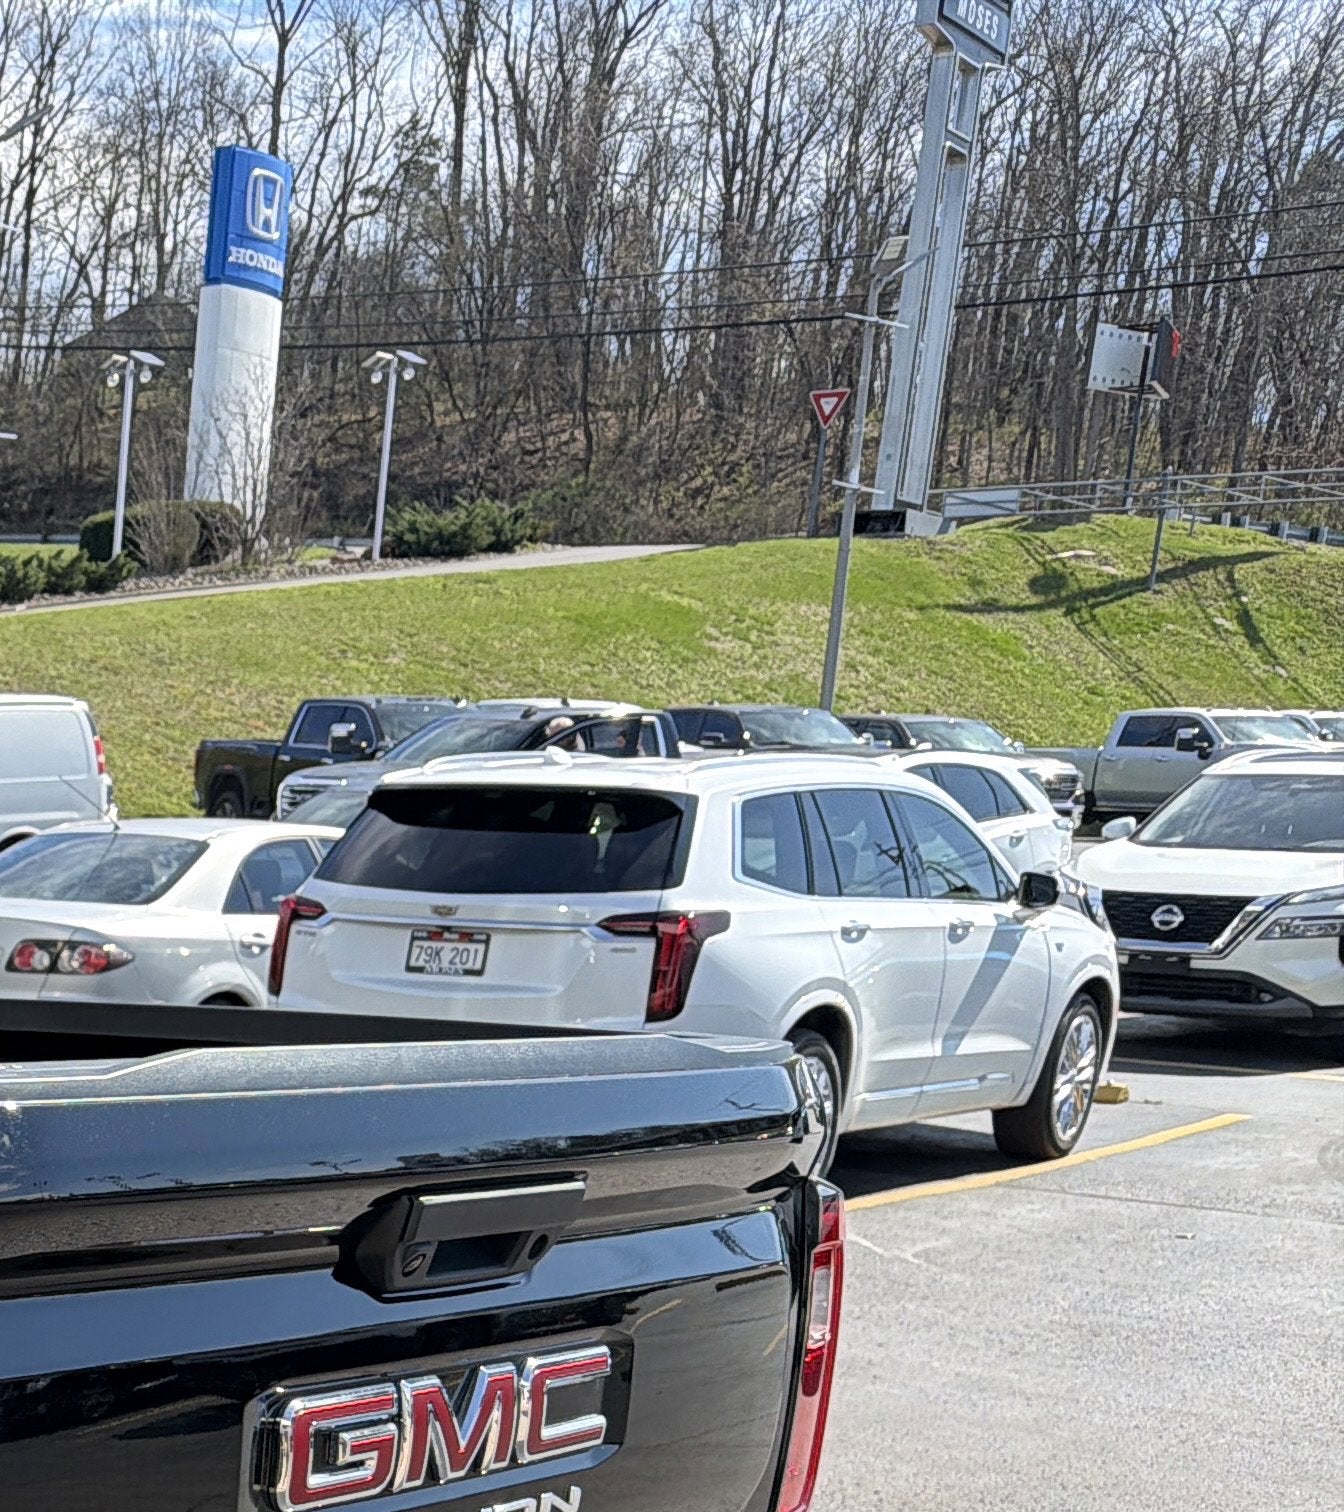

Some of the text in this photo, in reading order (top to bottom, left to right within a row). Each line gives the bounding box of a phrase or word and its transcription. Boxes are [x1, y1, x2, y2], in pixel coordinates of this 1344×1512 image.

[956, 0, 999, 40] MOSES
[227, 245, 284, 279] HONDA
[414, 944, 479, 966] 79K 201
[277, 1346, 611, 1512] GMC
